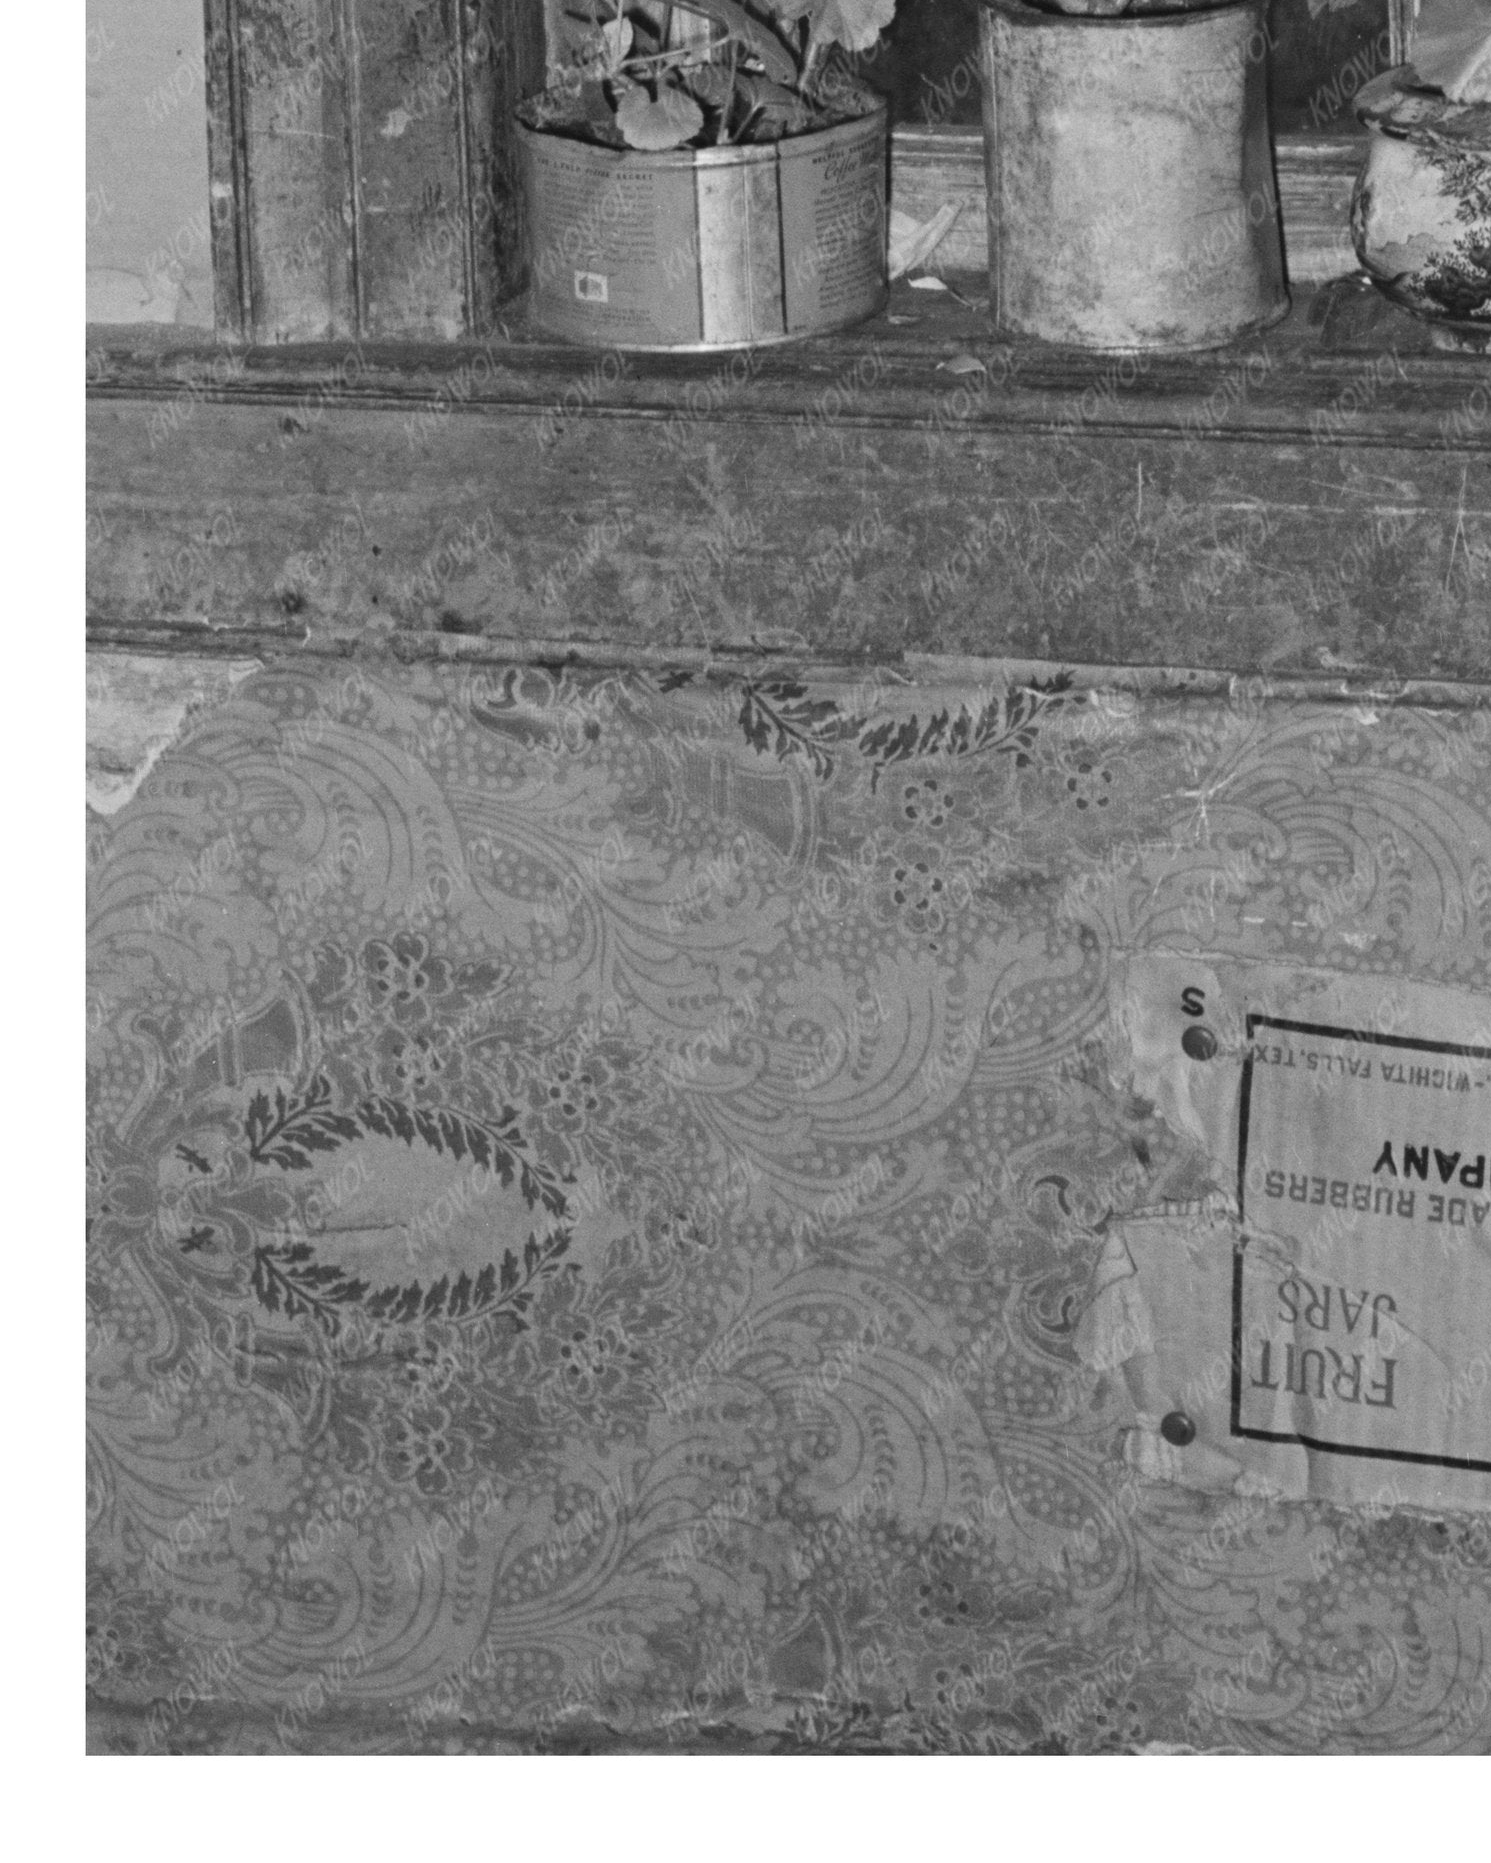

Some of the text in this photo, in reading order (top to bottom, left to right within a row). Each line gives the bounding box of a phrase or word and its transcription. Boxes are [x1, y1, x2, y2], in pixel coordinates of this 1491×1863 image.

[1180, 986, 1207, 1019] S
[1380, 1062, 1471, 1093] WICHITA
[1264, 1169, 1417, 1220] RUBBERS
[1276, 1275, 1397, 1338] JARS
[1250, 1338, 1397, 1410] FRUIT
